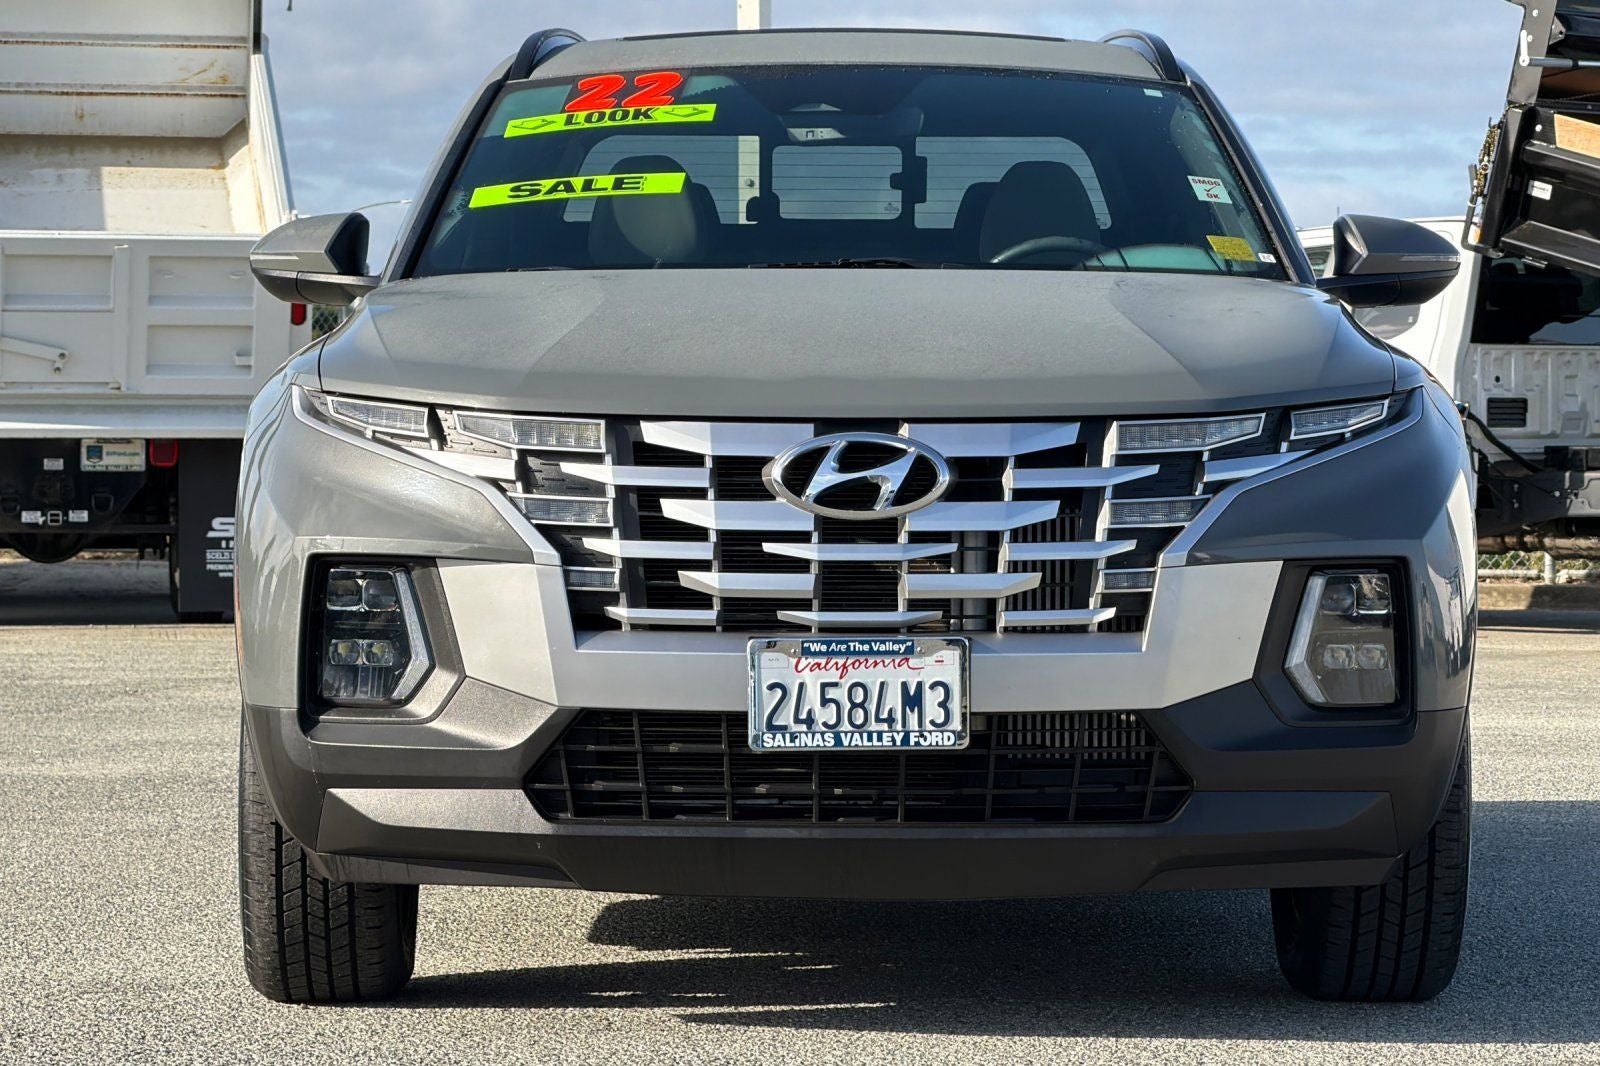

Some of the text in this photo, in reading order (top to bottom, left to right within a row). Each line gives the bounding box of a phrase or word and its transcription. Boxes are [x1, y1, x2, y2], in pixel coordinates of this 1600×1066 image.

[565, 72, 683, 112] 22
[564, 107, 659, 127] LOOK
[507, 175, 647, 199] SALE
[1191, 178, 1221, 186] SMOG
[829, 642, 847, 652] Are
[848, 642, 870, 652] The
[794, 656, 925, 680] California
[764, 681, 951, 731] 24584M3
[763, 732, 956, 747] SALINAS VALLEY FORD
